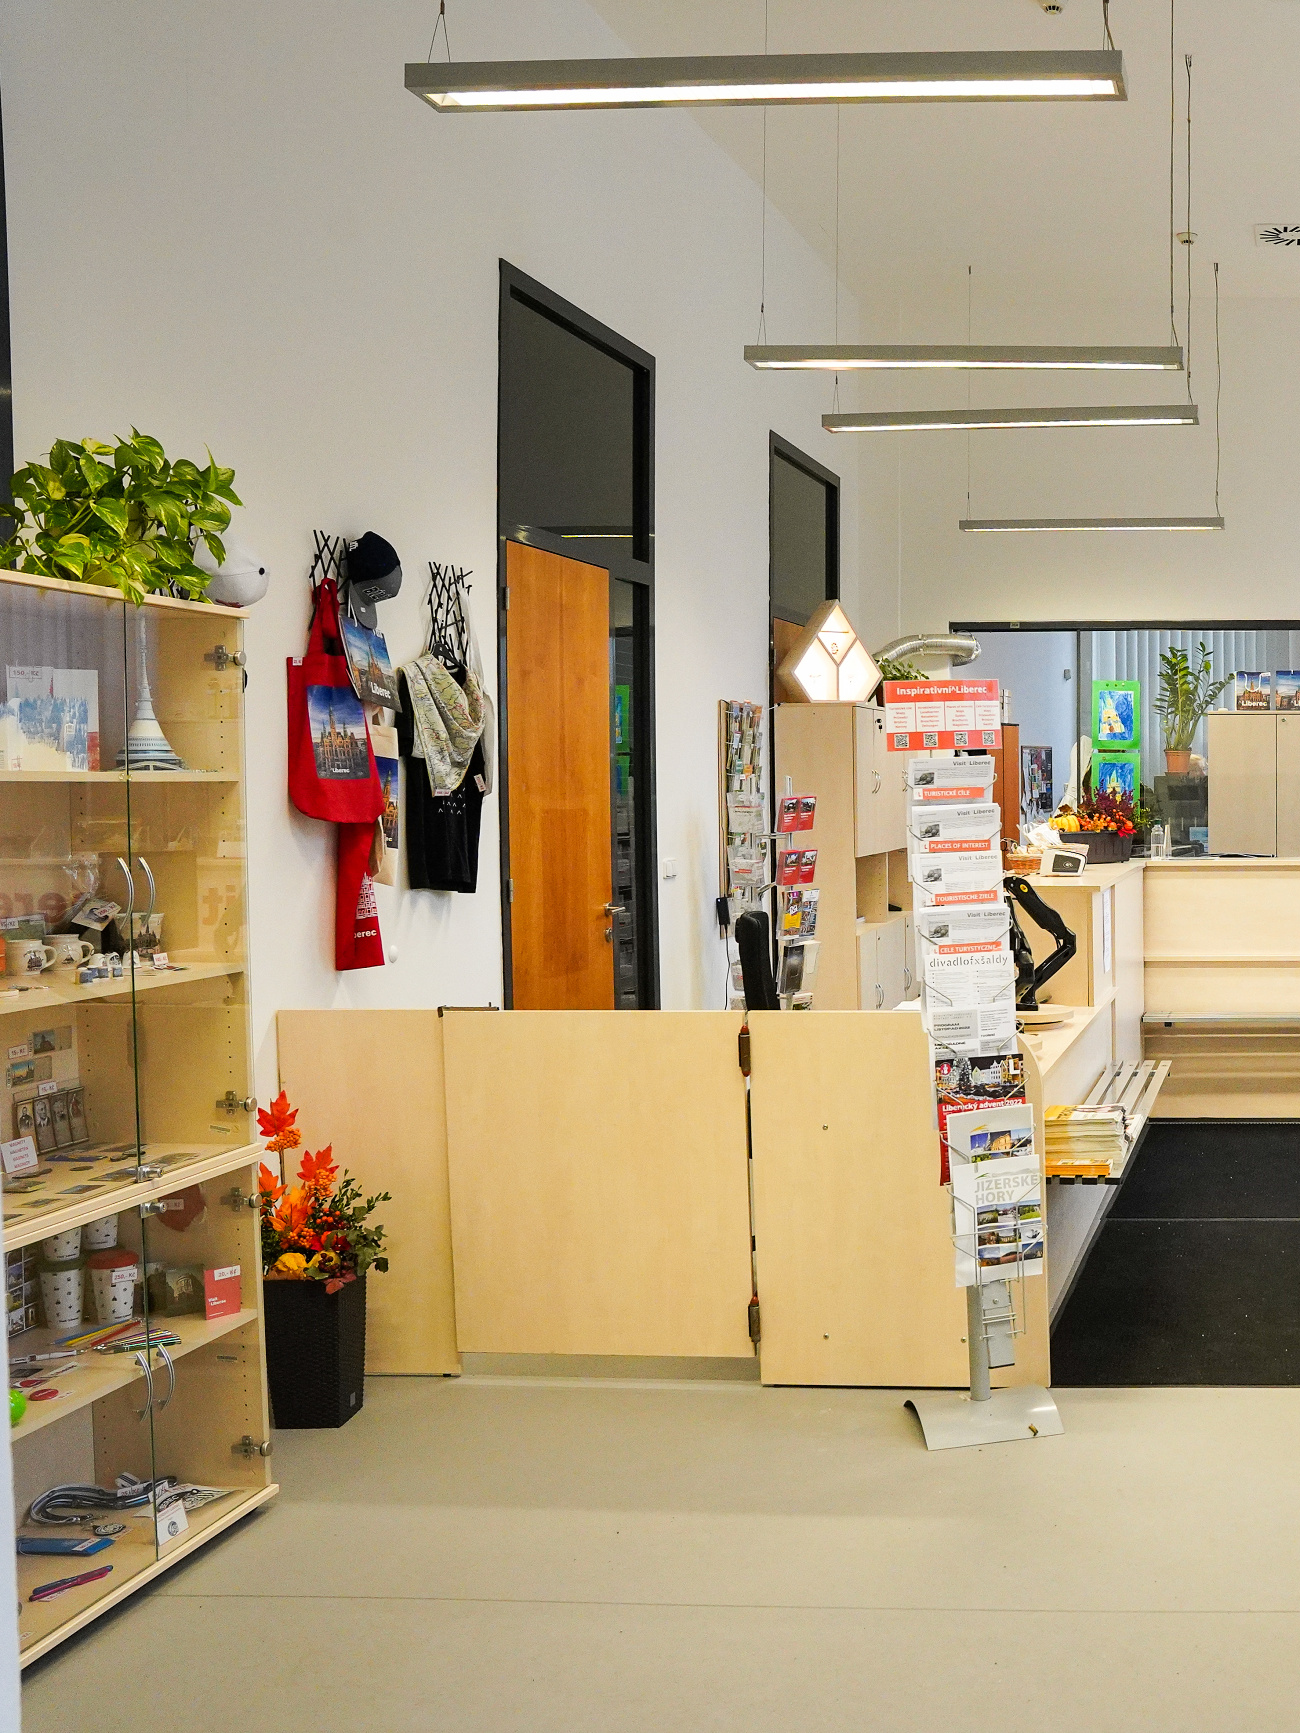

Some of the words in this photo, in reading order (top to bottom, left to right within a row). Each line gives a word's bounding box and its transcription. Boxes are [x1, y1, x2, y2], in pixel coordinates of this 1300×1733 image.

[371, 681, 391, 699] Liberec
[958, 788, 970, 796] CÍLE
[936, 894, 978, 902] TOURISTISCHE
[929, 955, 1008, 968] divadlofxšaldy
[979, 1101, 1004, 1109] advent
[975, 1190, 1014, 1205] HORY
